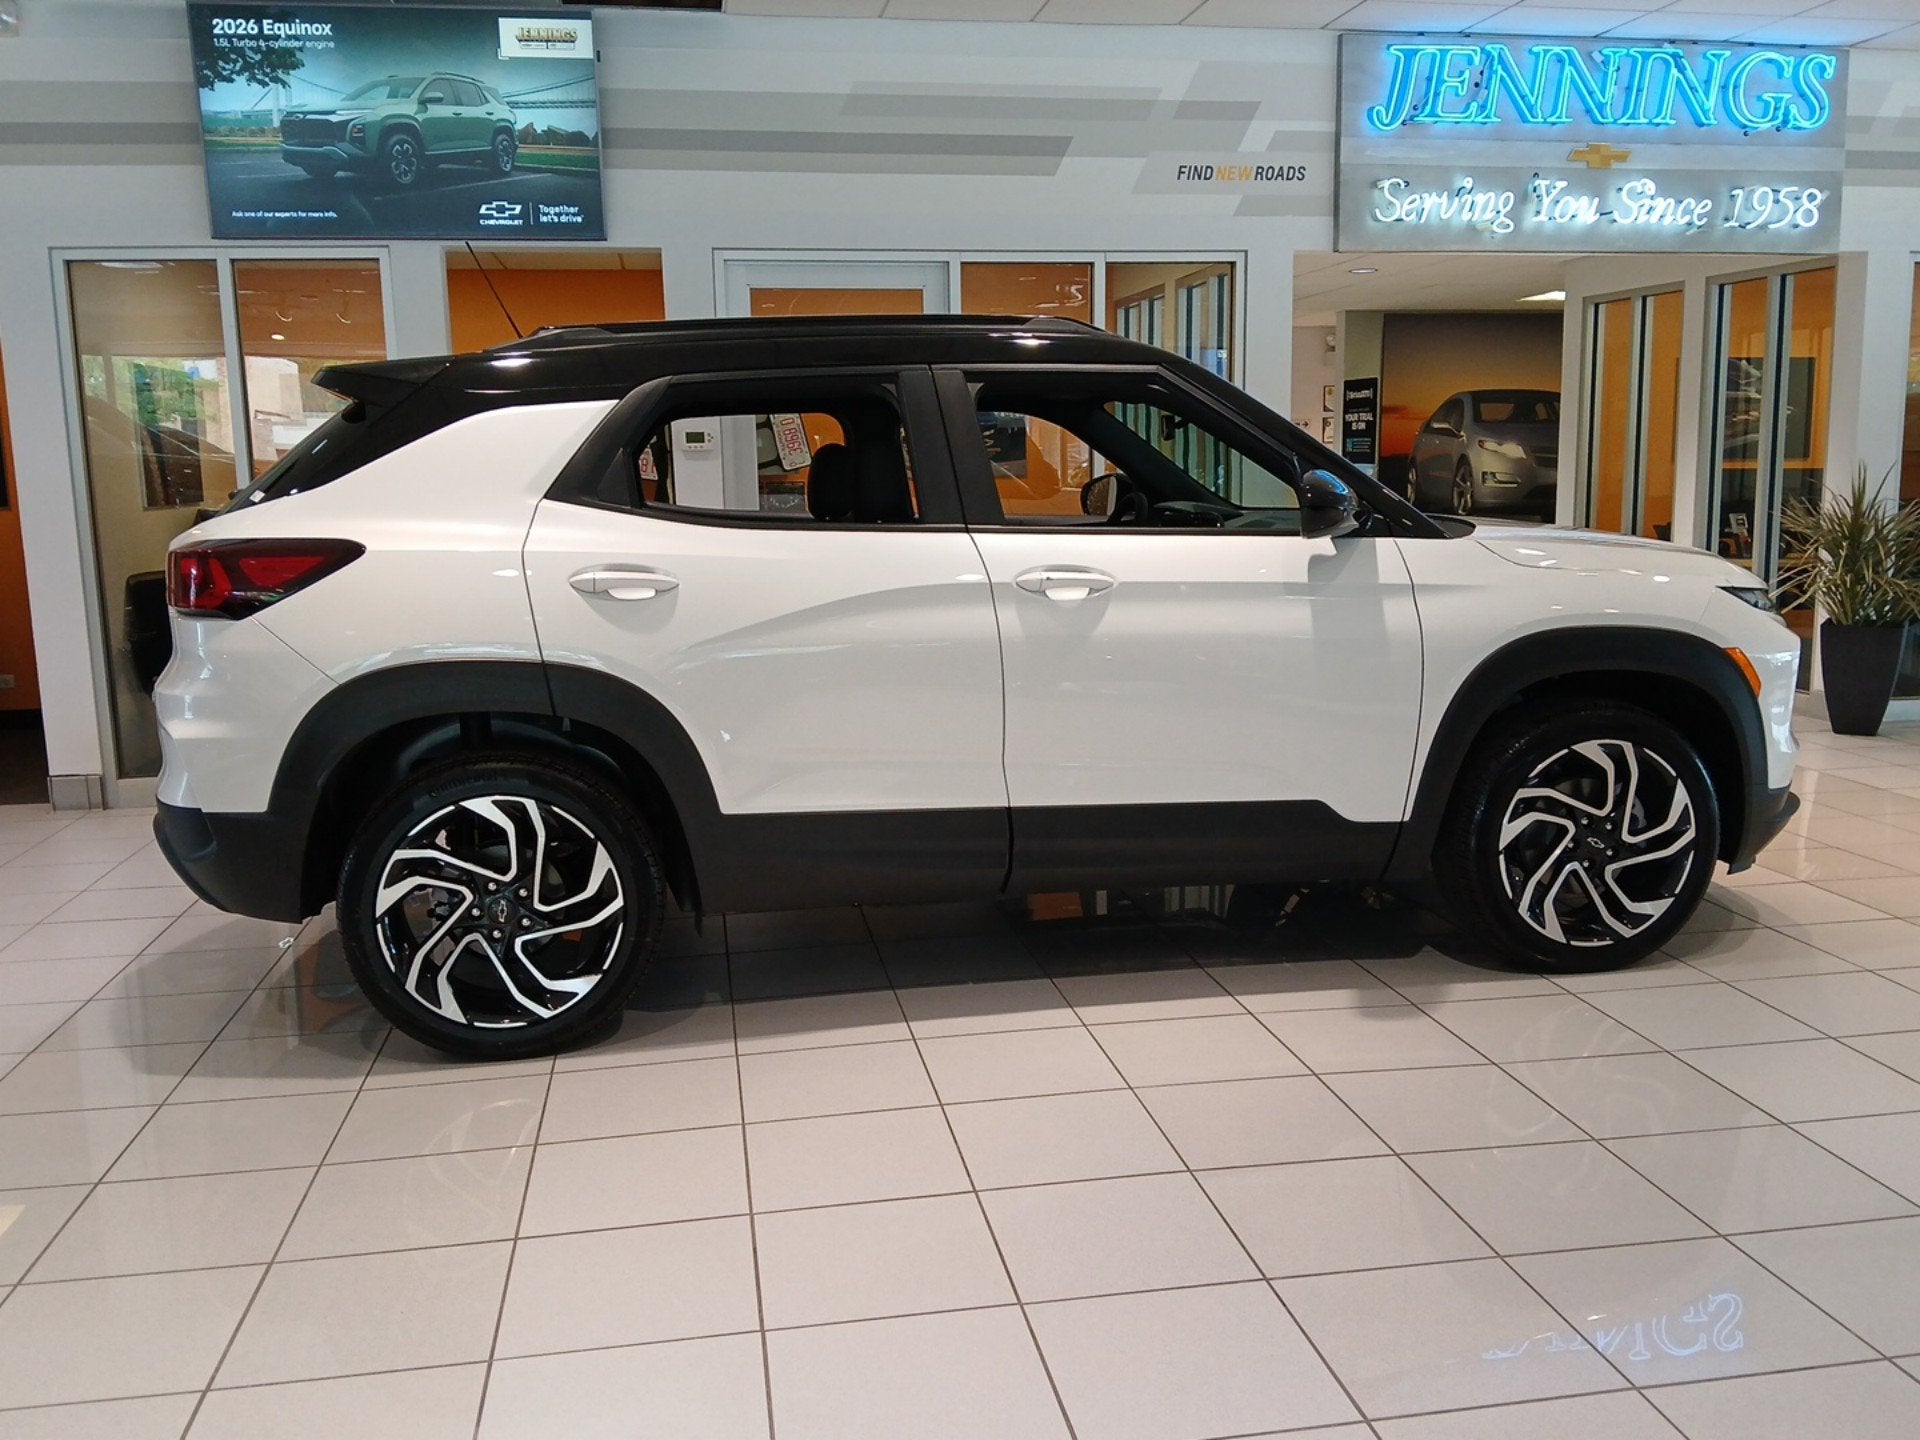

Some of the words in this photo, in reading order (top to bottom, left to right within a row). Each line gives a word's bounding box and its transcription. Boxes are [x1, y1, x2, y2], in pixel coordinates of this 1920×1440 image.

[212, 18, 259, 34] 2026
[262, 18, 333, 38] Equinox
[516, 27, 577, 43] JENNINGS
[213, 38, 231, 47] 1.5L
[232, 38, 257, 47] Turbo
[259, 38, 303, 49] 4-cylinder
[304, 39, 335, 49] engine
[1367, 42, 1837, 132] JENNINGS
[1177, 165, 1214, 181] FIND
[1216, 166, 1254, 181] NEW
[1254, 166, 1306, 181] ROADS
[538, 204, 579, 215] Together
[1375, 178, 1515, 232] Serving
[1532, 179, 1601, 223] You
[1611, 179, 1713, 227] Since
[1724, 187, 1822, 229] 1958
[540, 213, 558, 223] let's
[560, 213, 583, 223] drive
